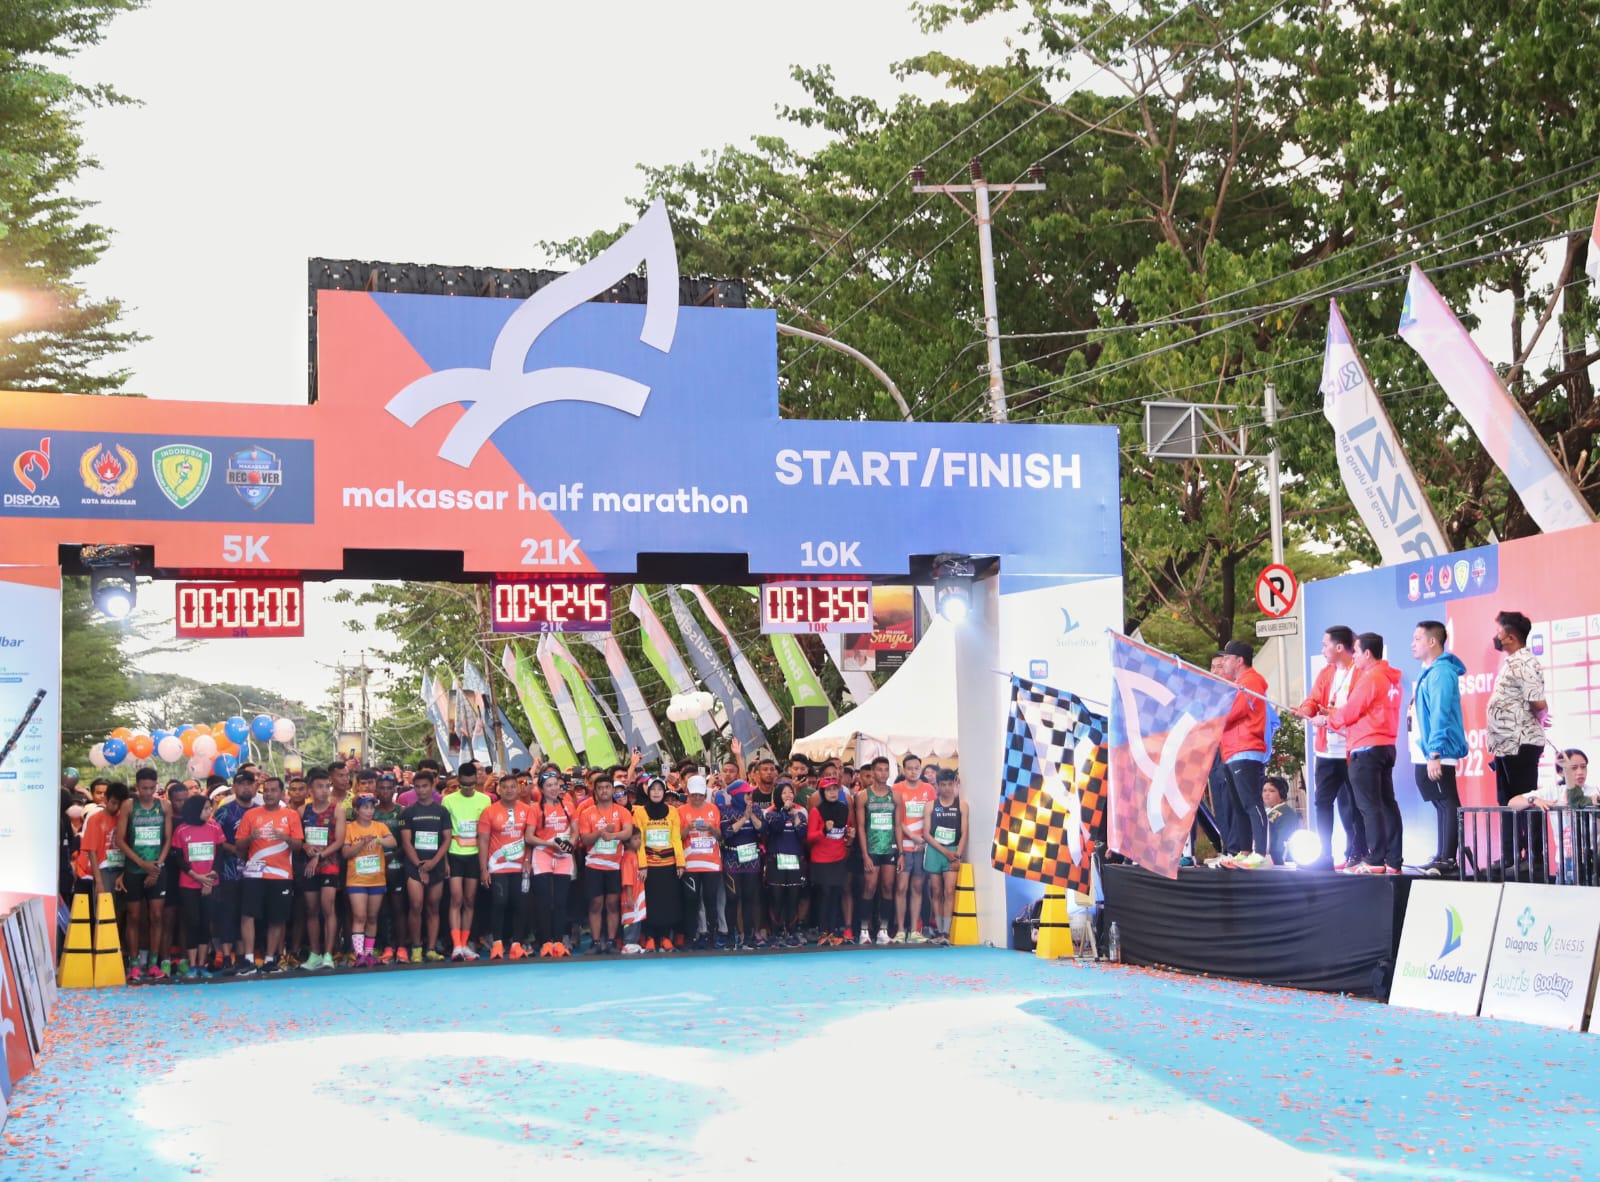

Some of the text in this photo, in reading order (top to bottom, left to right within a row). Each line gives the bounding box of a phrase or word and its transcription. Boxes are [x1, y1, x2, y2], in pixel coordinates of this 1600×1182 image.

[160, 448, 203, 459] INDONESIA
[3, 493, 60, 506] DISPORA
[100, 498, 137, 506] MAKASSAR
[342, 480, 748, 514] makassar half marathon
[222, 534, 271, 563] 5K
[520, 538, 581, 566] 21K
[800, 541, 863, 568] 10K
[179, 587, 300, 629] 00:00:00
[495, 583, 608, 622] 00:42:45
[765, 586, 870, 624] 00:13:56
[232, 627, 249, 637] 5K
[540, 622, 564, 632] 21K
[808, 622, 829, 633] 10K
[870, 629, 913, 649] Surya
[1504, 936, 1539, 954] Diagnos
[1554, 938, 1585, 953] ENESIS
